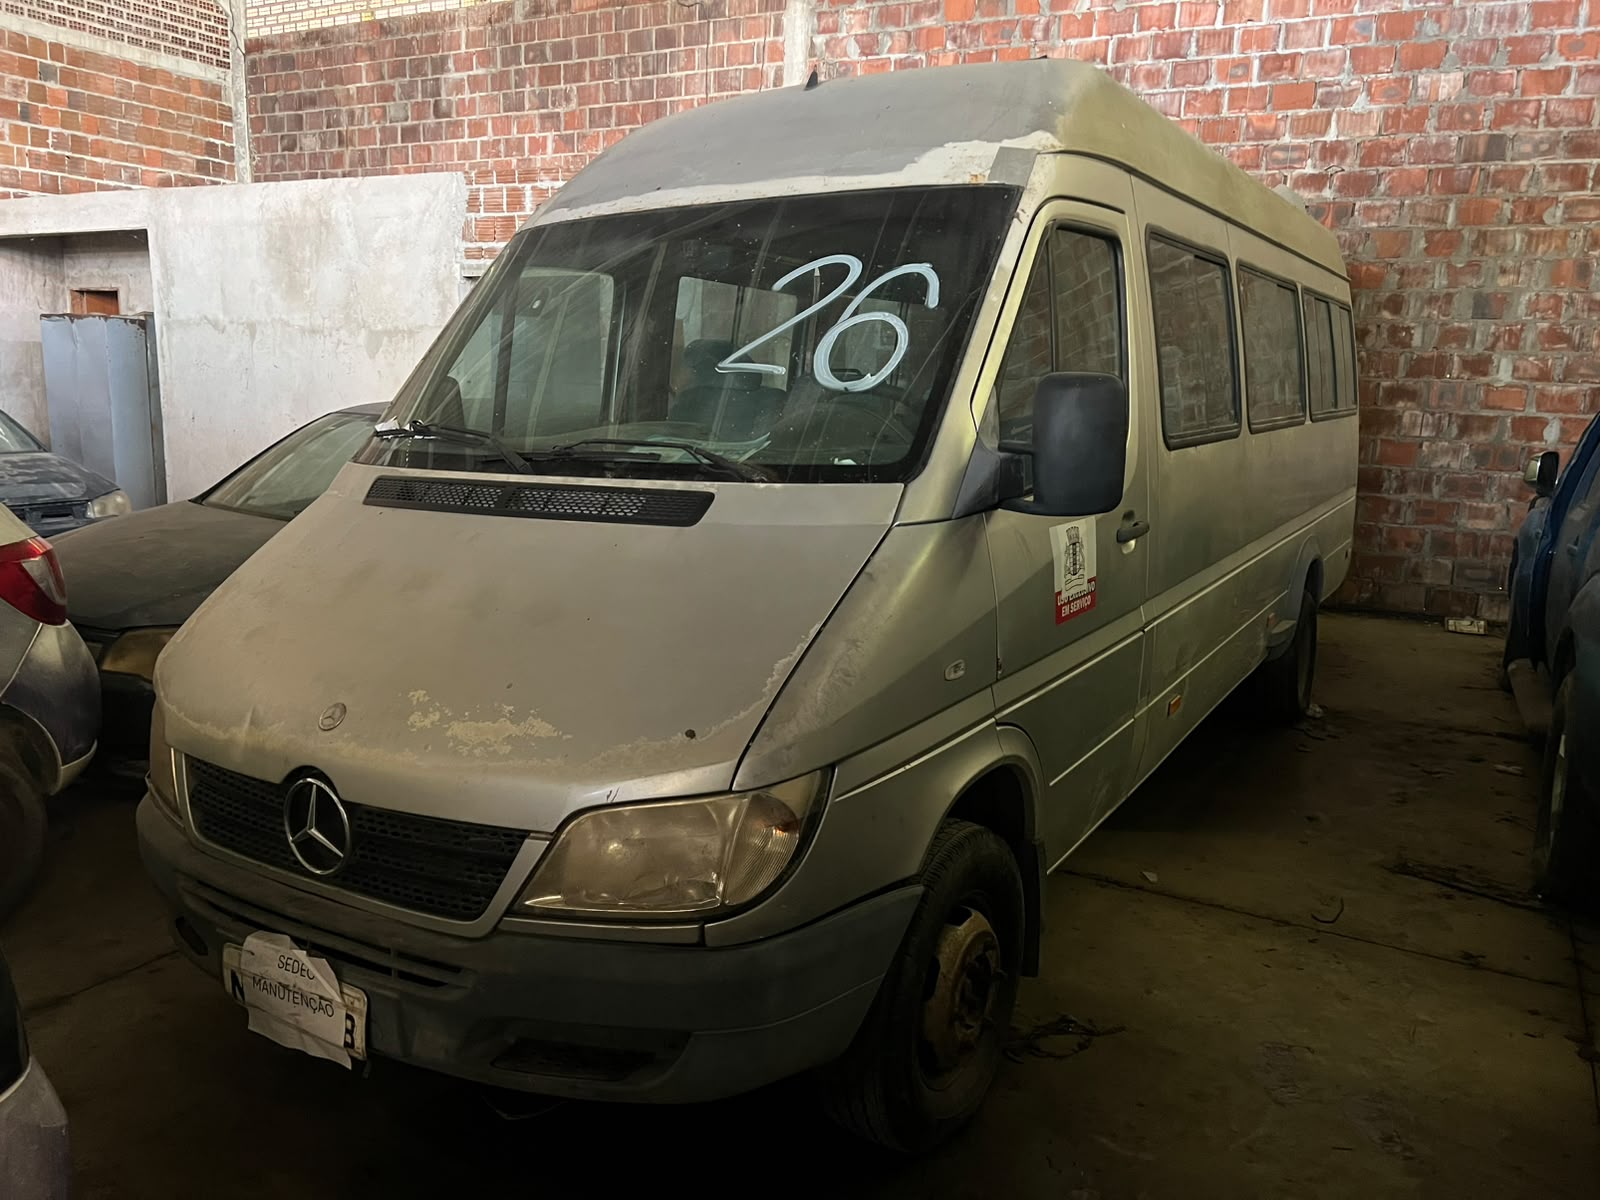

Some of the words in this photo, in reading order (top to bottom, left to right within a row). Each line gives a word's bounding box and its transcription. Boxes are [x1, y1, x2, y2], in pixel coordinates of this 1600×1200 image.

[715, 254, 940, 392] 26
[1062, 604, 1070, 617] EM
[1070, 595, 1092, 614] SERVIÇO
